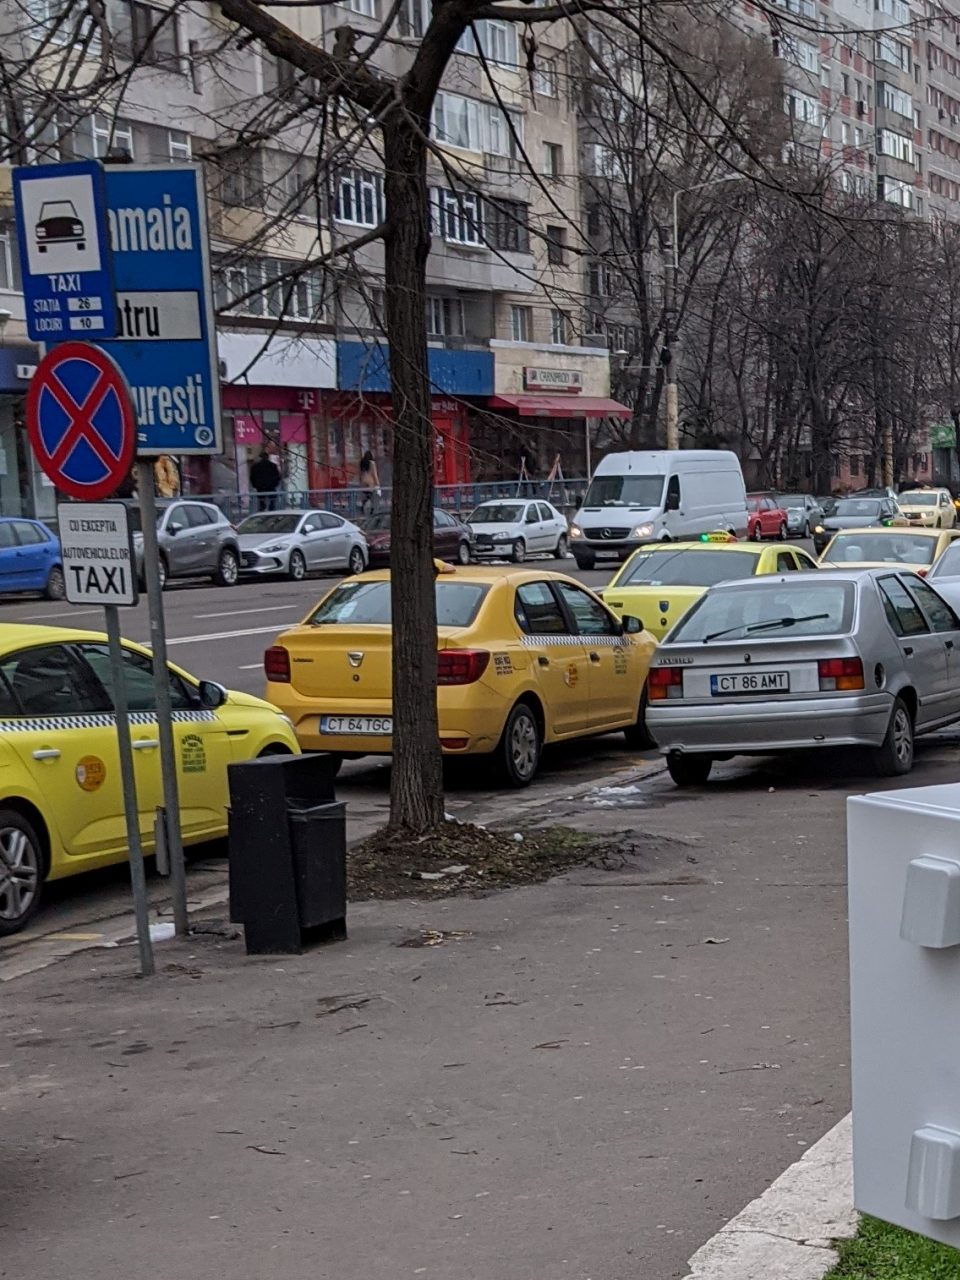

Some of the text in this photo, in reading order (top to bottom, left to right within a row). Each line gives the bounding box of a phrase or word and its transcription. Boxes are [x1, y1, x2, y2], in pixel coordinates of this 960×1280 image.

[48, 273, 82, 293] TAXI
[78, 297, 91, 310] 26
[35, 317, 92, 332] LOCURI 10
[63, 547, 129, 561] AUTOVEHICULELOR
[69, 565, 127, 596] TAXI
[720, 674, 785, 690] CT 86 AMT
[328, 718, 391, 731] CT 64 TGC
